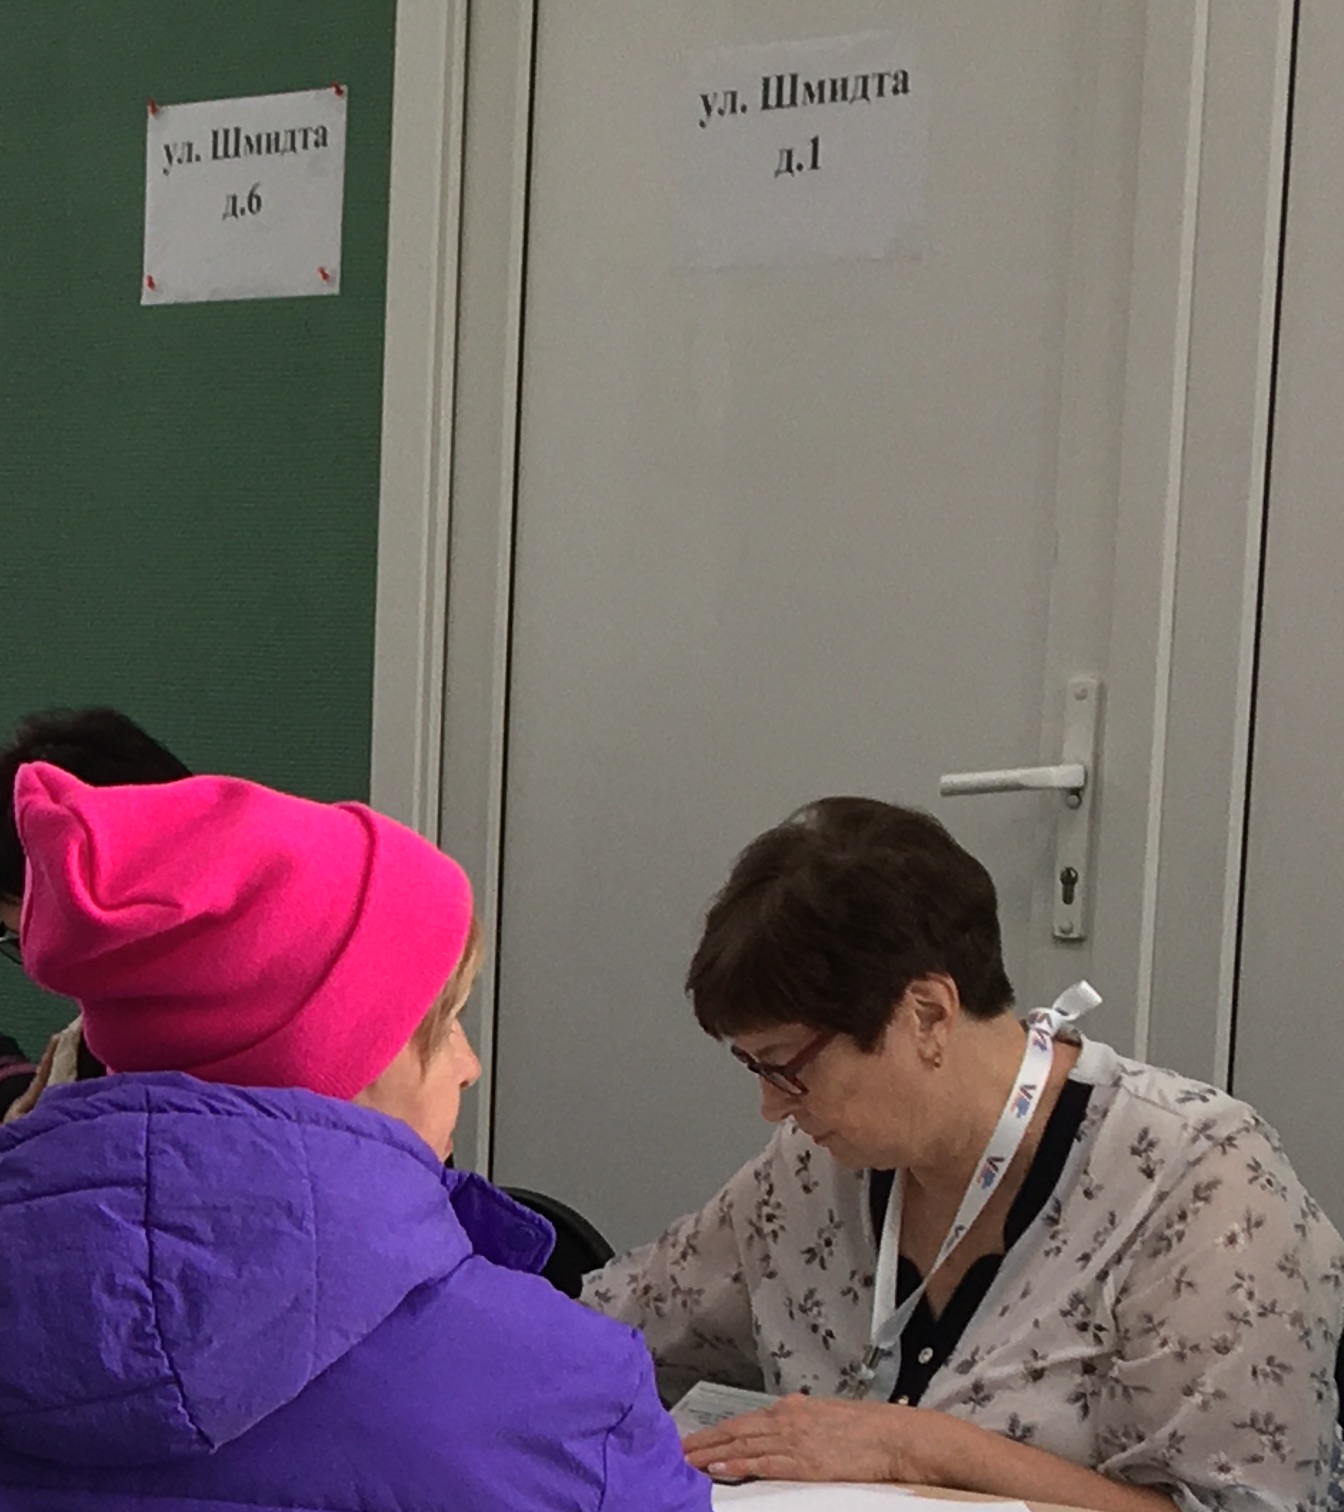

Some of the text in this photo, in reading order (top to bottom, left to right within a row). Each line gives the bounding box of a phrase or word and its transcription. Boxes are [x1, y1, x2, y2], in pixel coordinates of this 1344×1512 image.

[698, 68, 910, 129] ул. Шмидта
[163, 125, 328, 175] ул. Шмидта
[773, 134, 821, 178] д.1
[222, 181, 262, 221] д.6
